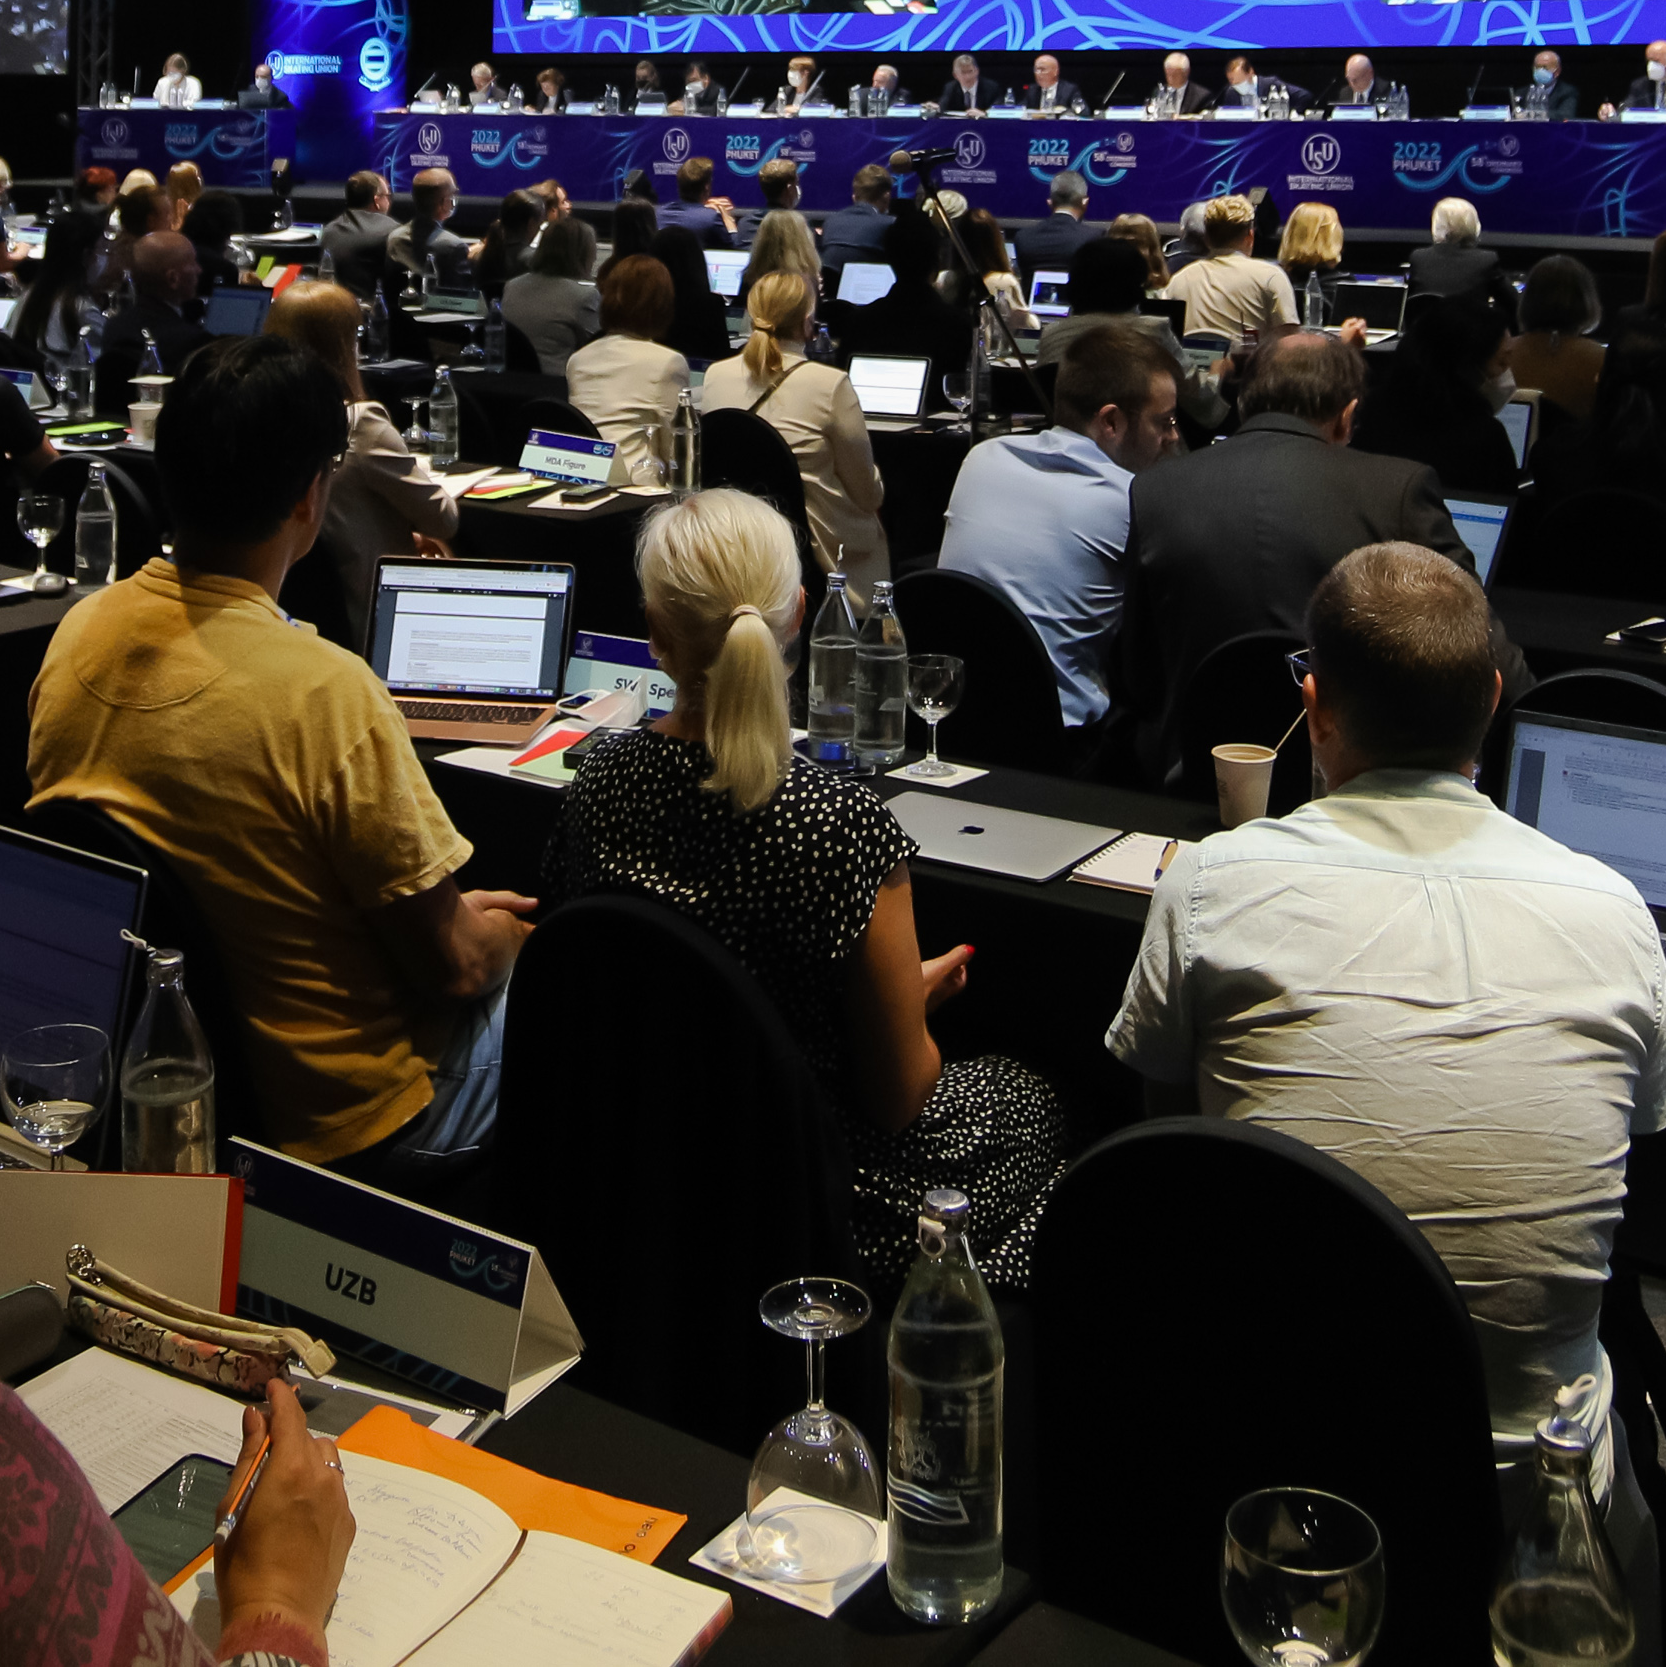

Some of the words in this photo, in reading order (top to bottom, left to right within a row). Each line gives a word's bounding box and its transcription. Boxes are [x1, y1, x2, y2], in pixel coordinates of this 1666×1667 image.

[472, 130, 501, 143] 2022
[726, 135, 761, 150] 2022
[471, 142, 500, 153] PHUKET
[1029, 139, 1070, 156] 2022
[1393, 141, 1442, 160] 2022
[1028, 154, 1070, 166] PHUKET
[1392, 159, 1442, 172] PHUKET
[563, 459, 586, 470] Figure
[649, 684, 675, 700] Spe
[451, 1238, 478, 1255] 2022
[325, 1263, 377, 1306] UZB
